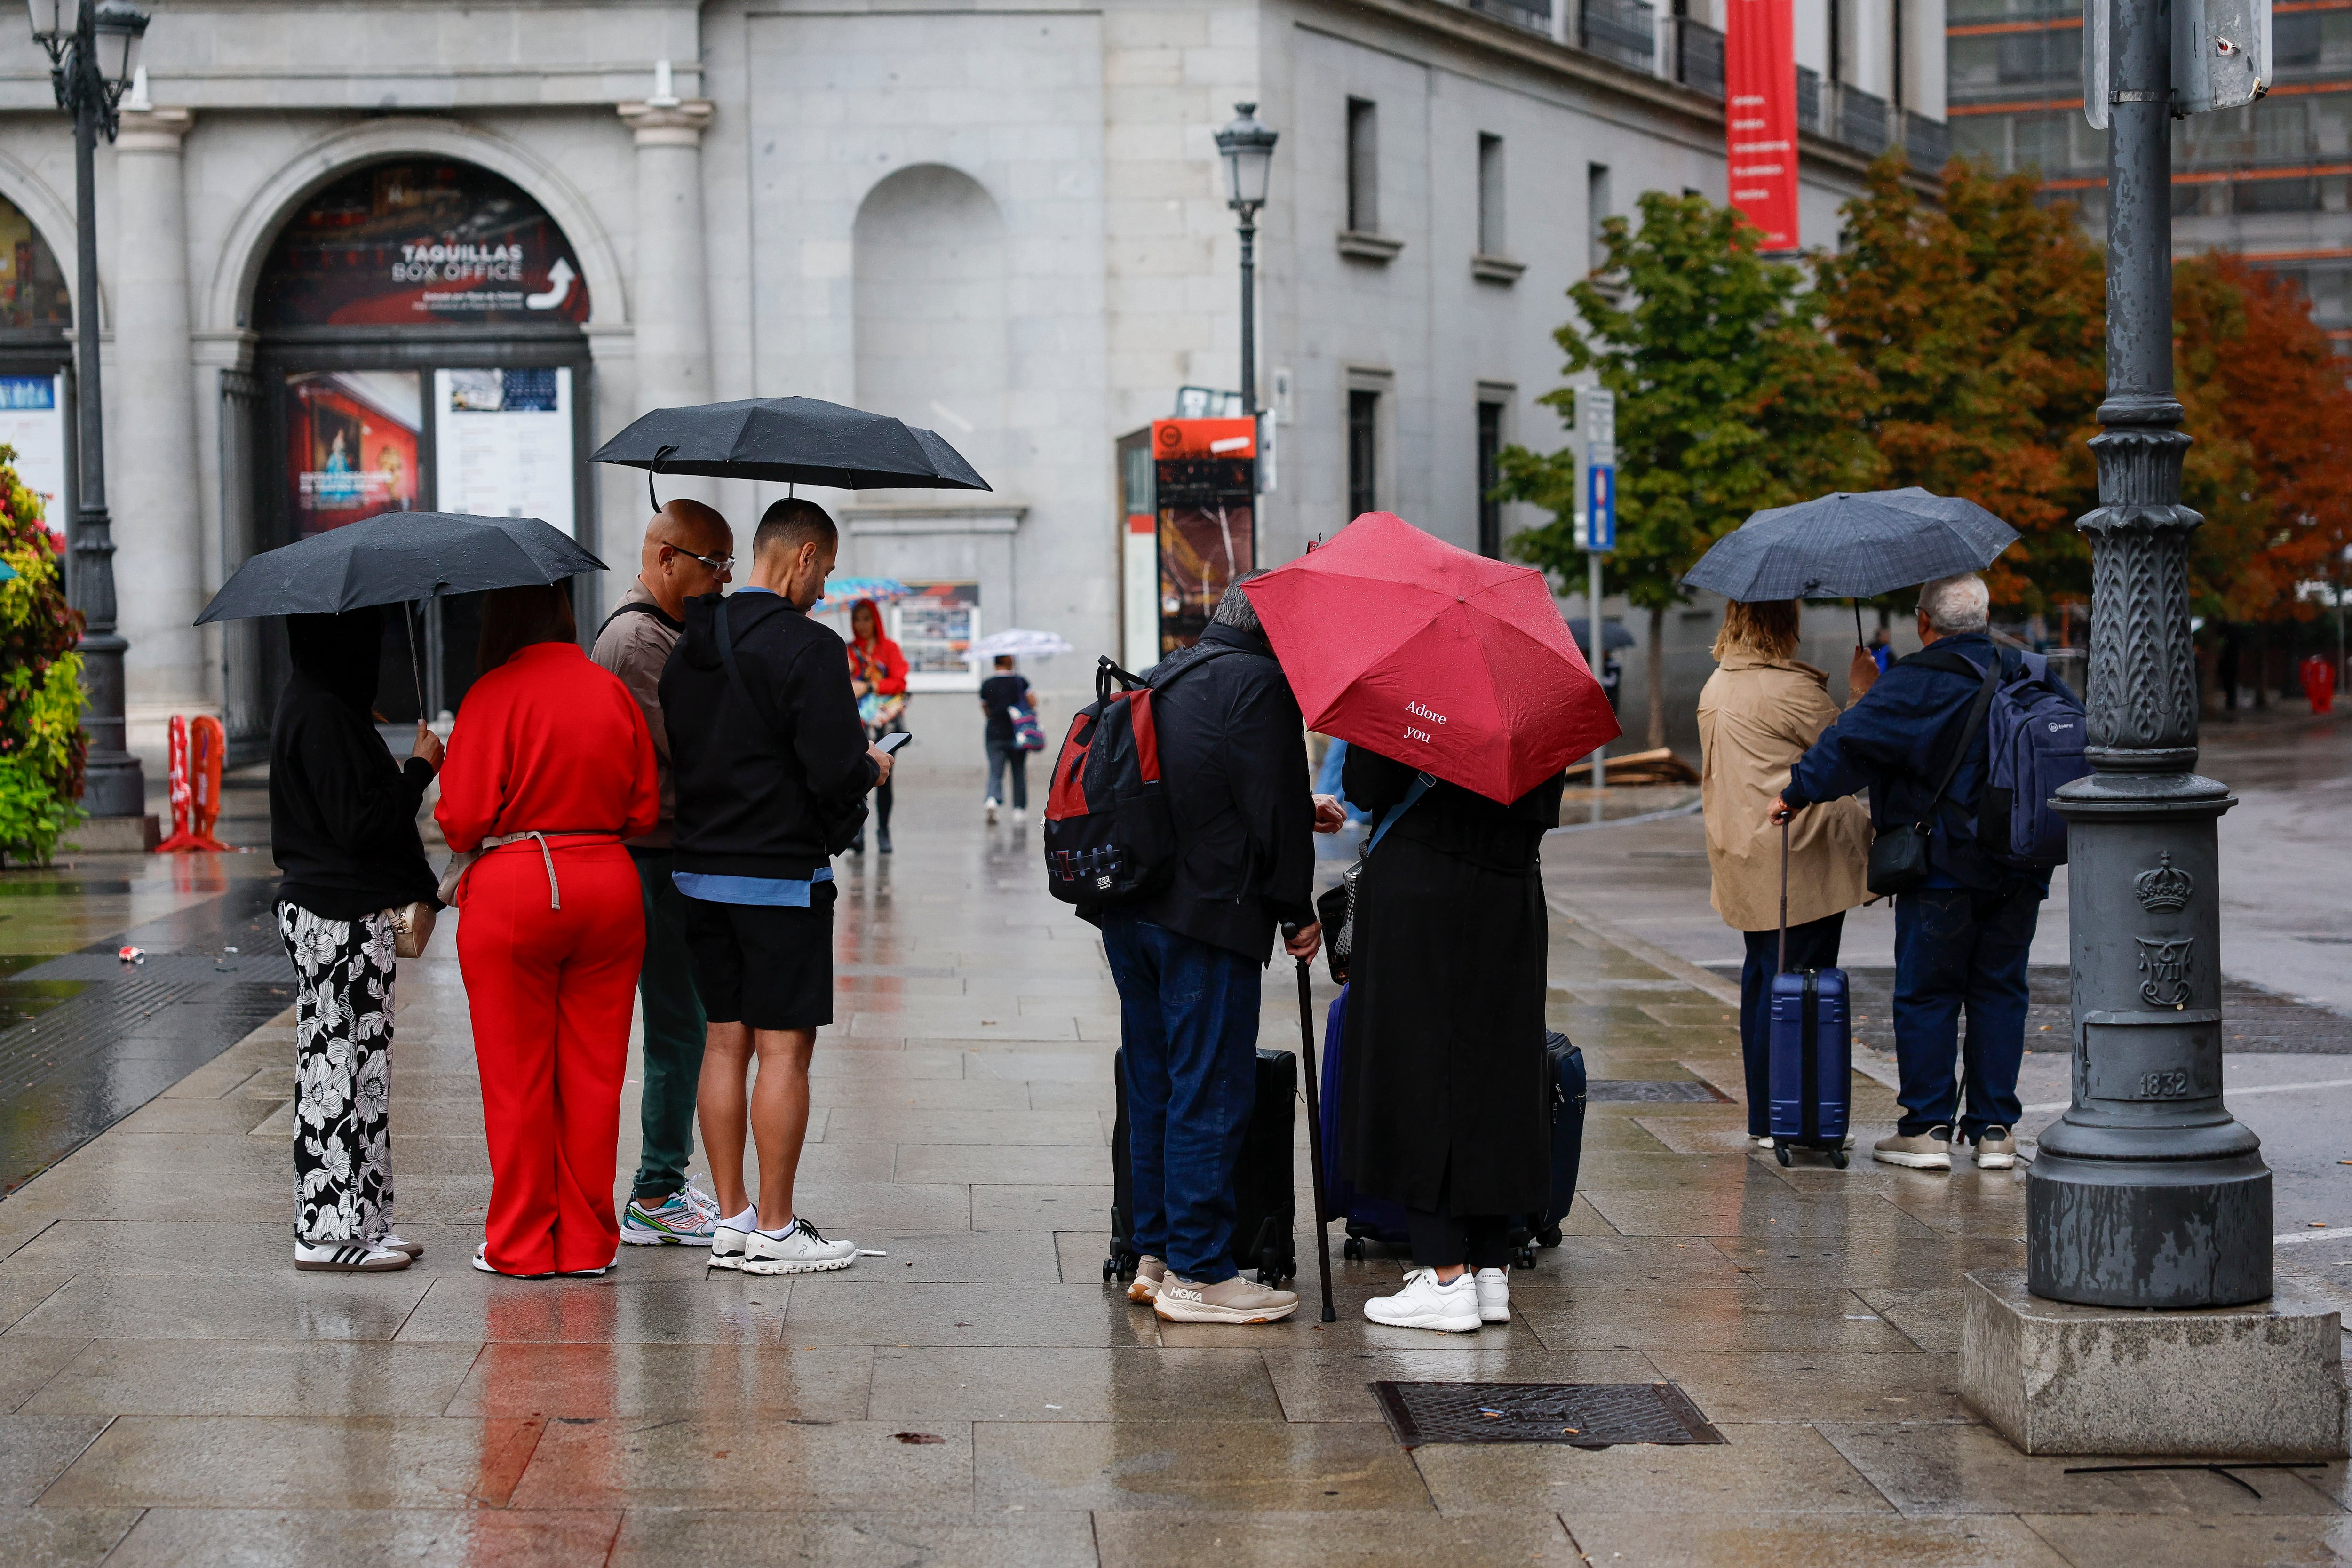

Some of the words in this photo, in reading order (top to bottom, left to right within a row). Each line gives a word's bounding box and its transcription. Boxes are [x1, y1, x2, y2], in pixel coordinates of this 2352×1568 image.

[401, 243, 523, 263] TAQUILLAS
[392, 262, 437, 283] BOX
[443, 261, 523, 282] OFFICE
[1405, 700, 1446, 725] Adore
[1403, 726, 1430, 743] you
[2141, 1072, 2186, 1096] 1832
[1170, 1286, 1202, 1303] HOKA
